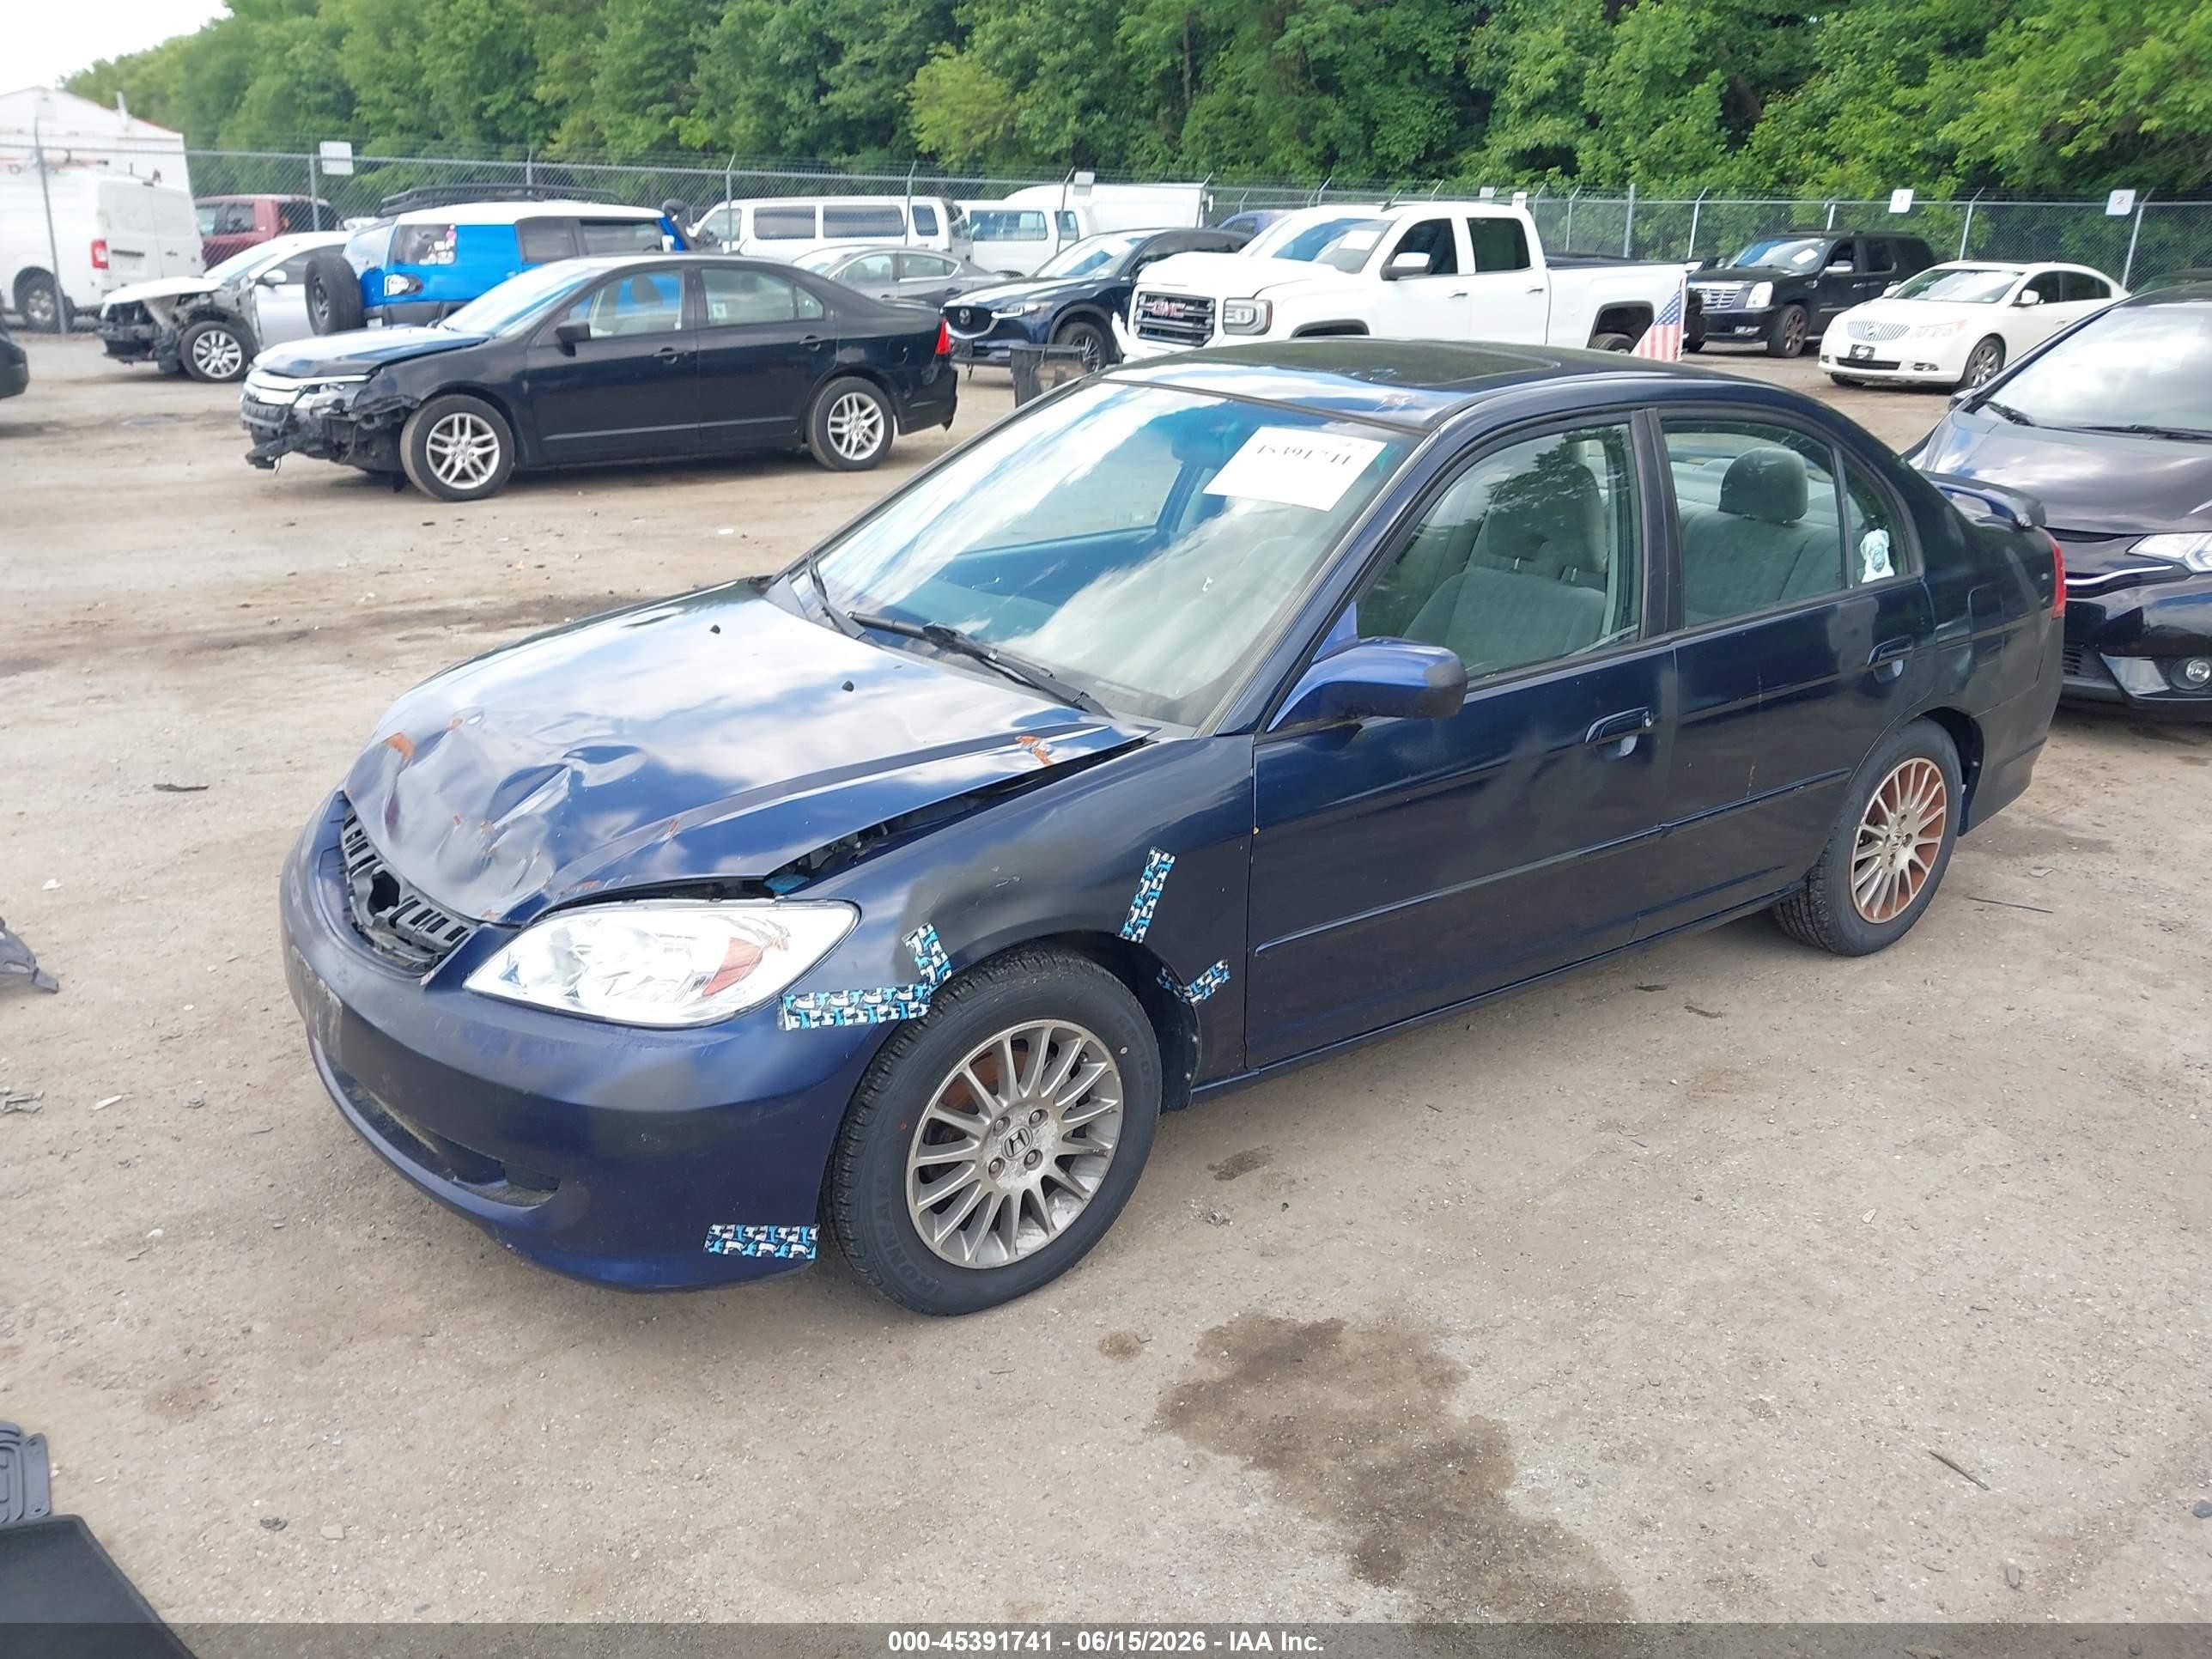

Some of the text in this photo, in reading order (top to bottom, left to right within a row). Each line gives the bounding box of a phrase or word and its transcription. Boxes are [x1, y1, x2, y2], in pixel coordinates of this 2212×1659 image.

[2116, 196, 2125, 206] 2
[1152, 301, 1186, 318] GMC
[876, 1175, 945, 1296] IRONMAN
